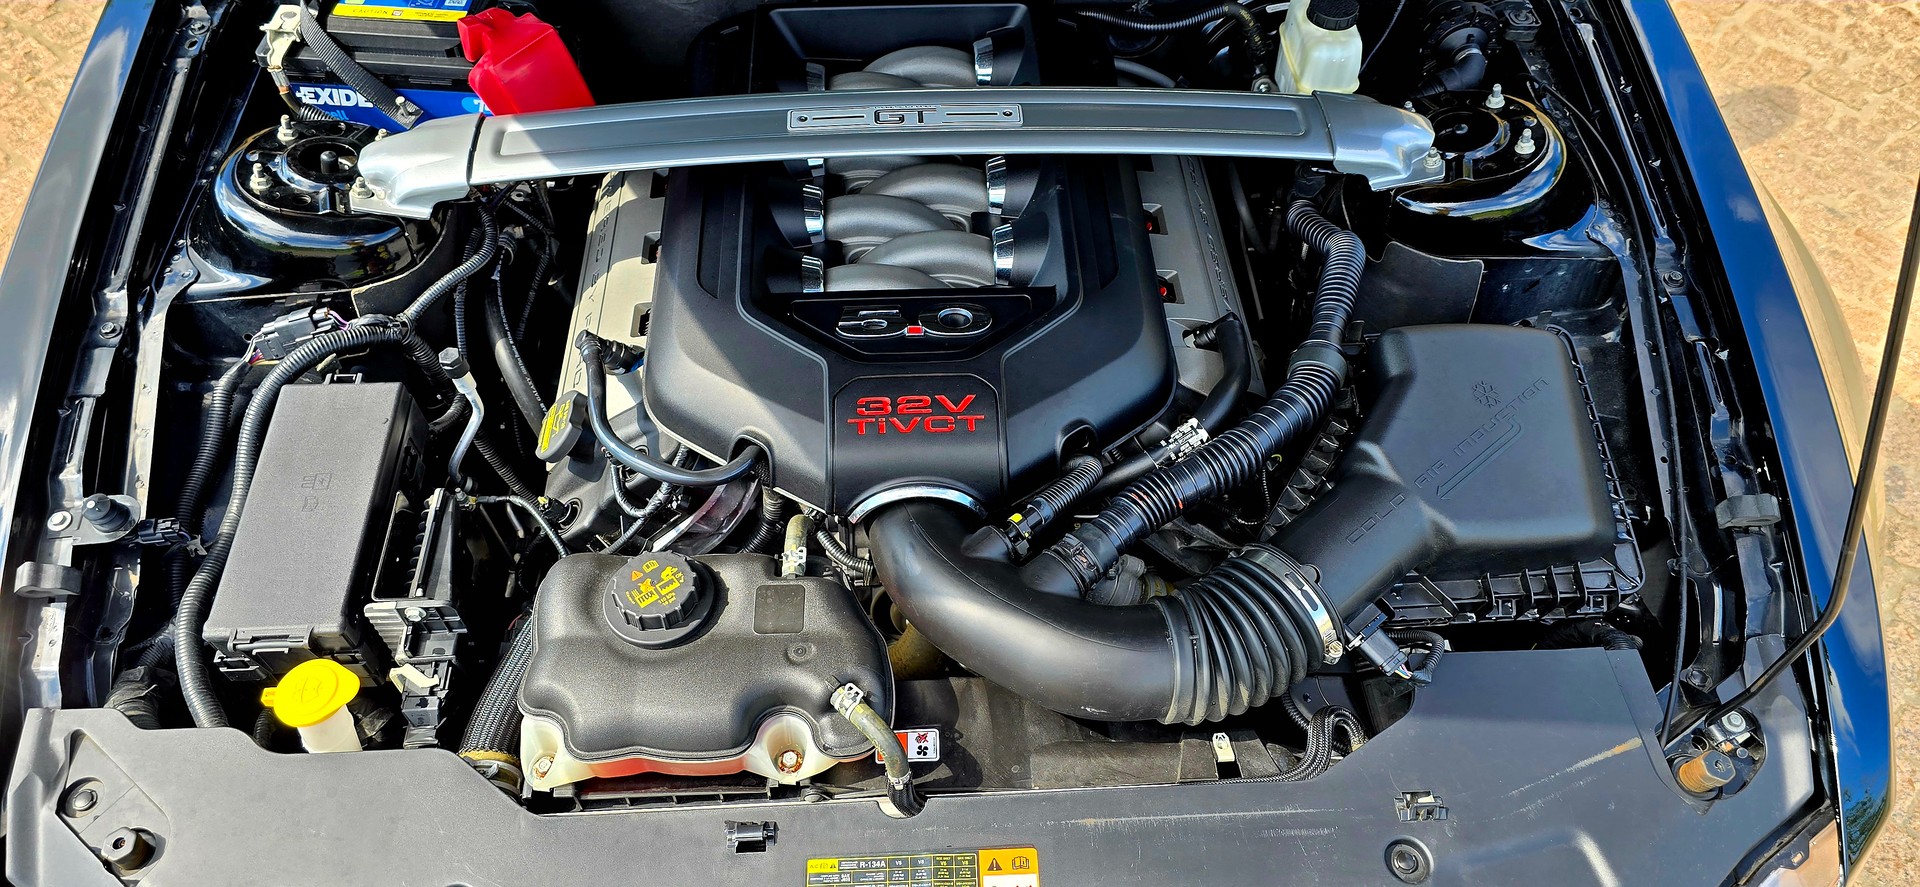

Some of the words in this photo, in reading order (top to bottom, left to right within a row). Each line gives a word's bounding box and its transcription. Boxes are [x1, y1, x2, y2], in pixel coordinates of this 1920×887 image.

[874, 108, 937, 125] GT
[835, 303, 993, 339] 5.0
[523, 375, 542, 402] GALAXY
[856, 394, 977, 416] 32V
[847, 415, 985, 435] TiVCT
[1345, 493, 1405, 546] COLD
[1413, 458, 1448, 489] AIR
[1452, 376, 1550, 457] INDUCTION
[860, 860, 886, 868] R-134A
